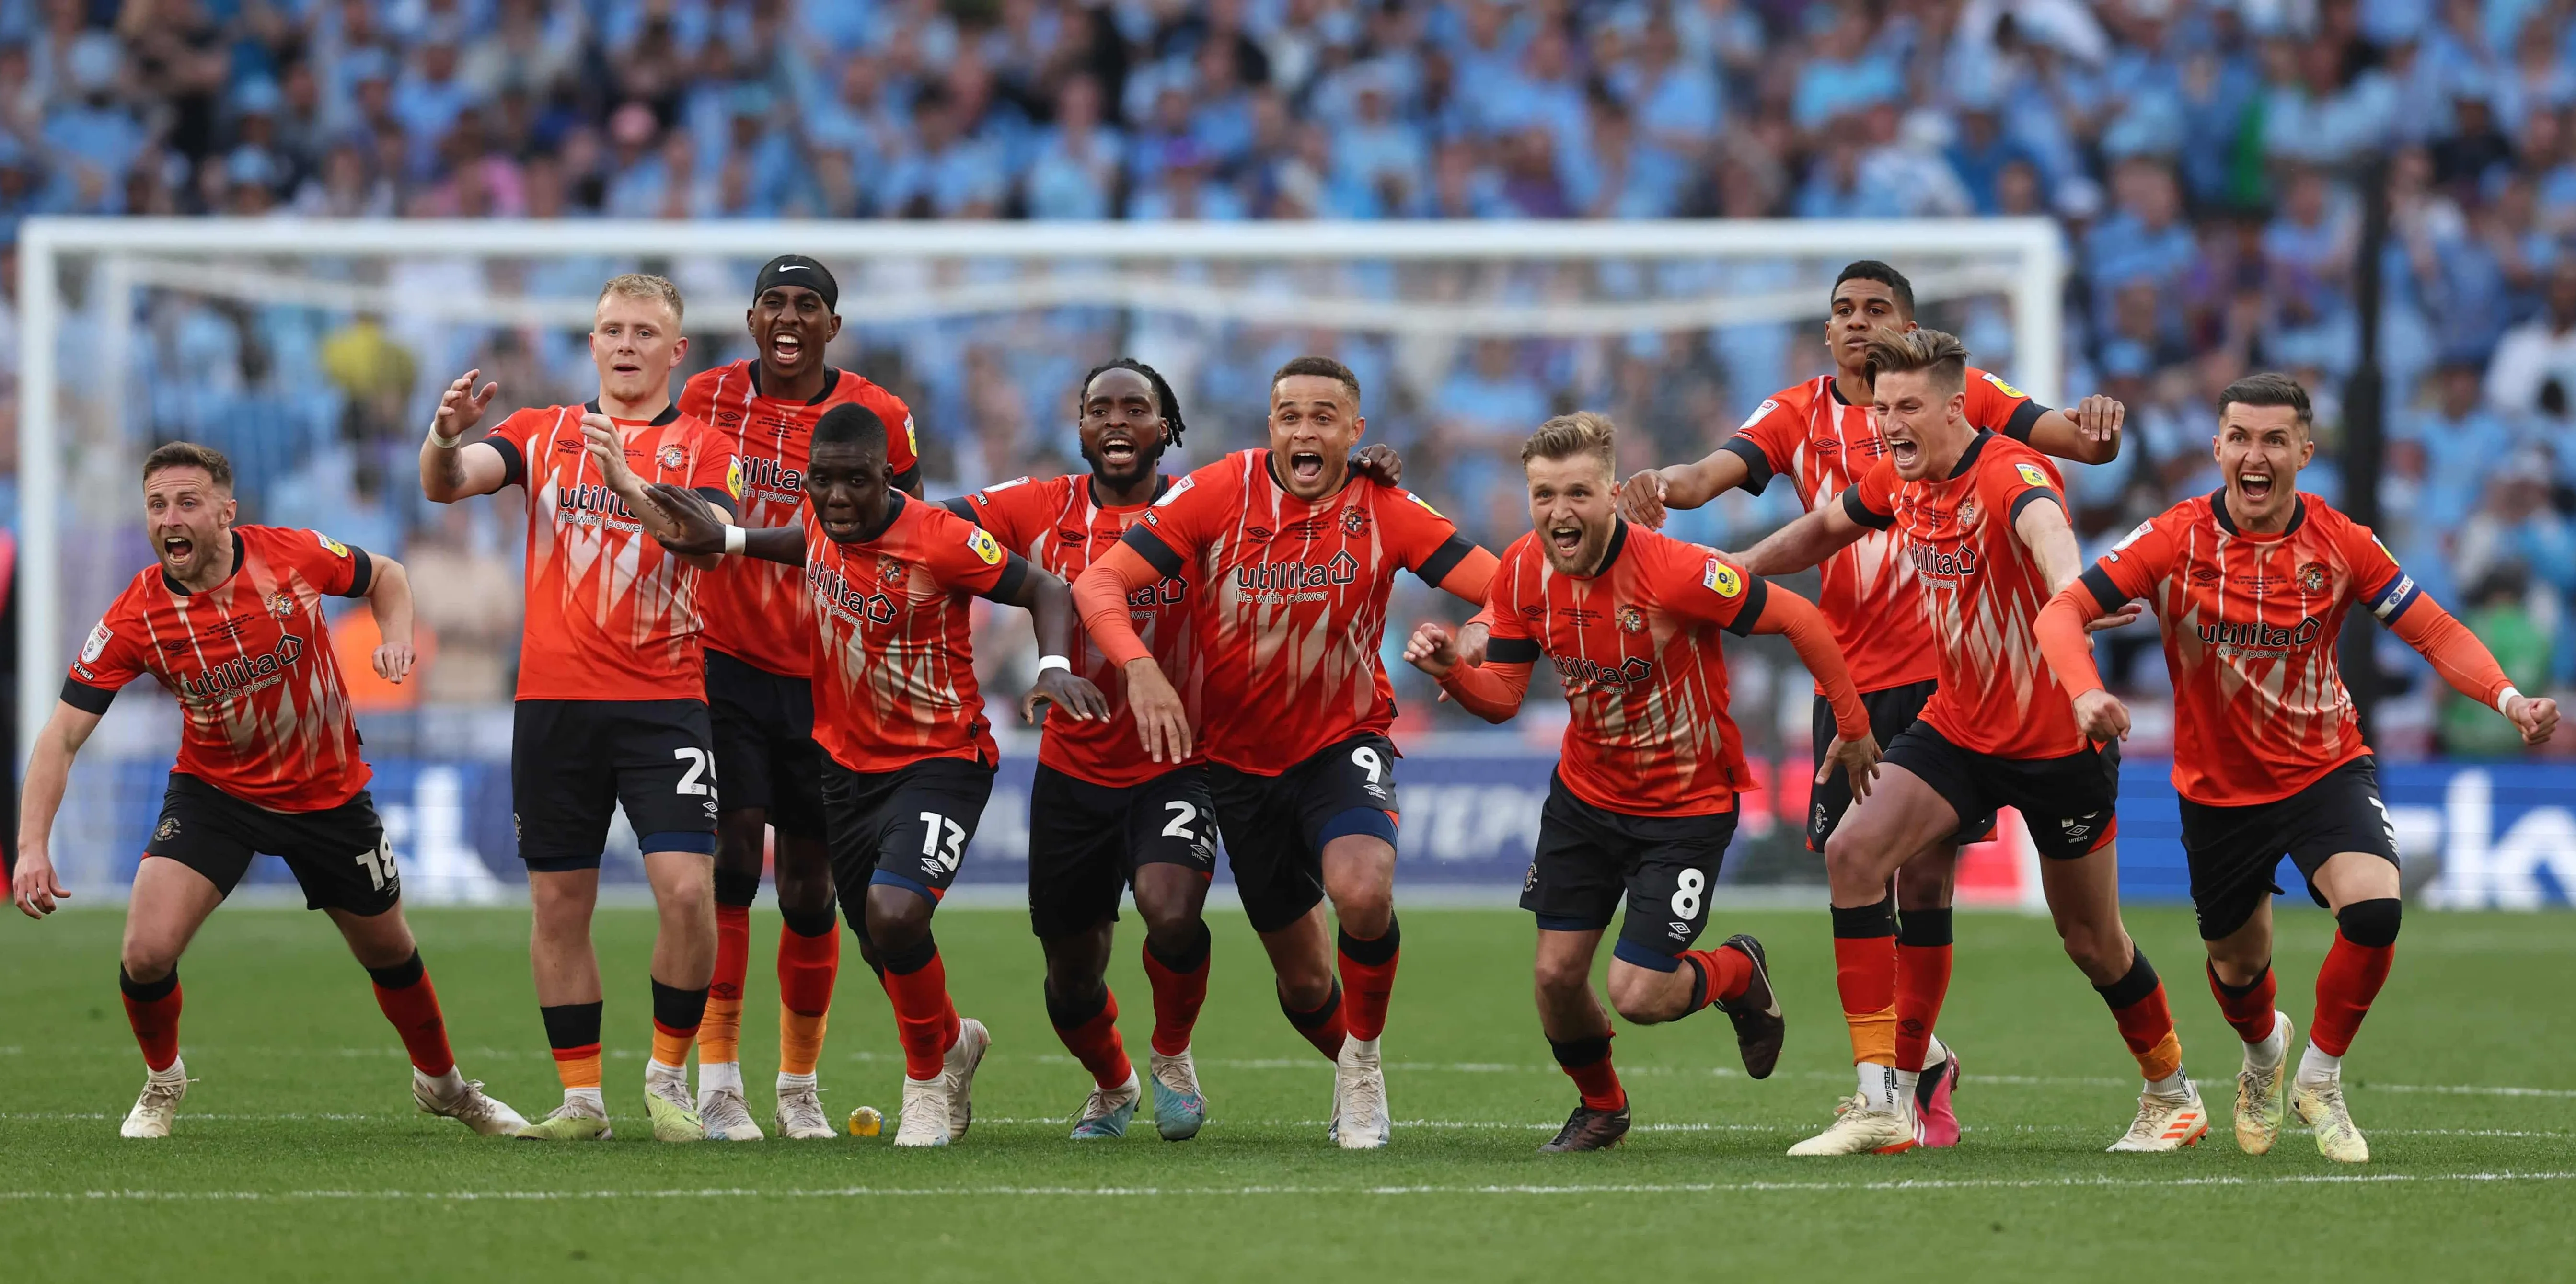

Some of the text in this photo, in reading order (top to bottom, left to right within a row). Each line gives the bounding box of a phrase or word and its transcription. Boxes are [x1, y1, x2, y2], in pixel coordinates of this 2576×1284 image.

[743, 455, 802, 492] ilita
[559, 483, 638, 519] utilit
[743, 484, 800, 505] th power
[558, 511, 645, 534] life with power
[808, 559, 865, 616] utilita
[1237, 560, 1328, 590] utilita
[1235, 589, 1328, 606] life with power
[2398, 584, 2409, 595] EFL
[832, 603, 863, 627] power
[2197, 621, 2291, 646] utilita
[2217, 646, 2290, 661] with power
[186, 654, 279, 696] utilita
[214, 674, 282, 704] with power
[1351, 746, 1382, 784] 9
[920, 811, 966, 871] 13
[1162, 801, 1216, 857] 23
[2068, 835, 2088, 843] umbro
[355, 830, 397, 892] 18
[1191, 851, 1208, 864] umbro
[920, 865, 938, 879] umbro
[1671, 868, 1705, 920] 8
[1668, 931, 1686, 942] umbro
